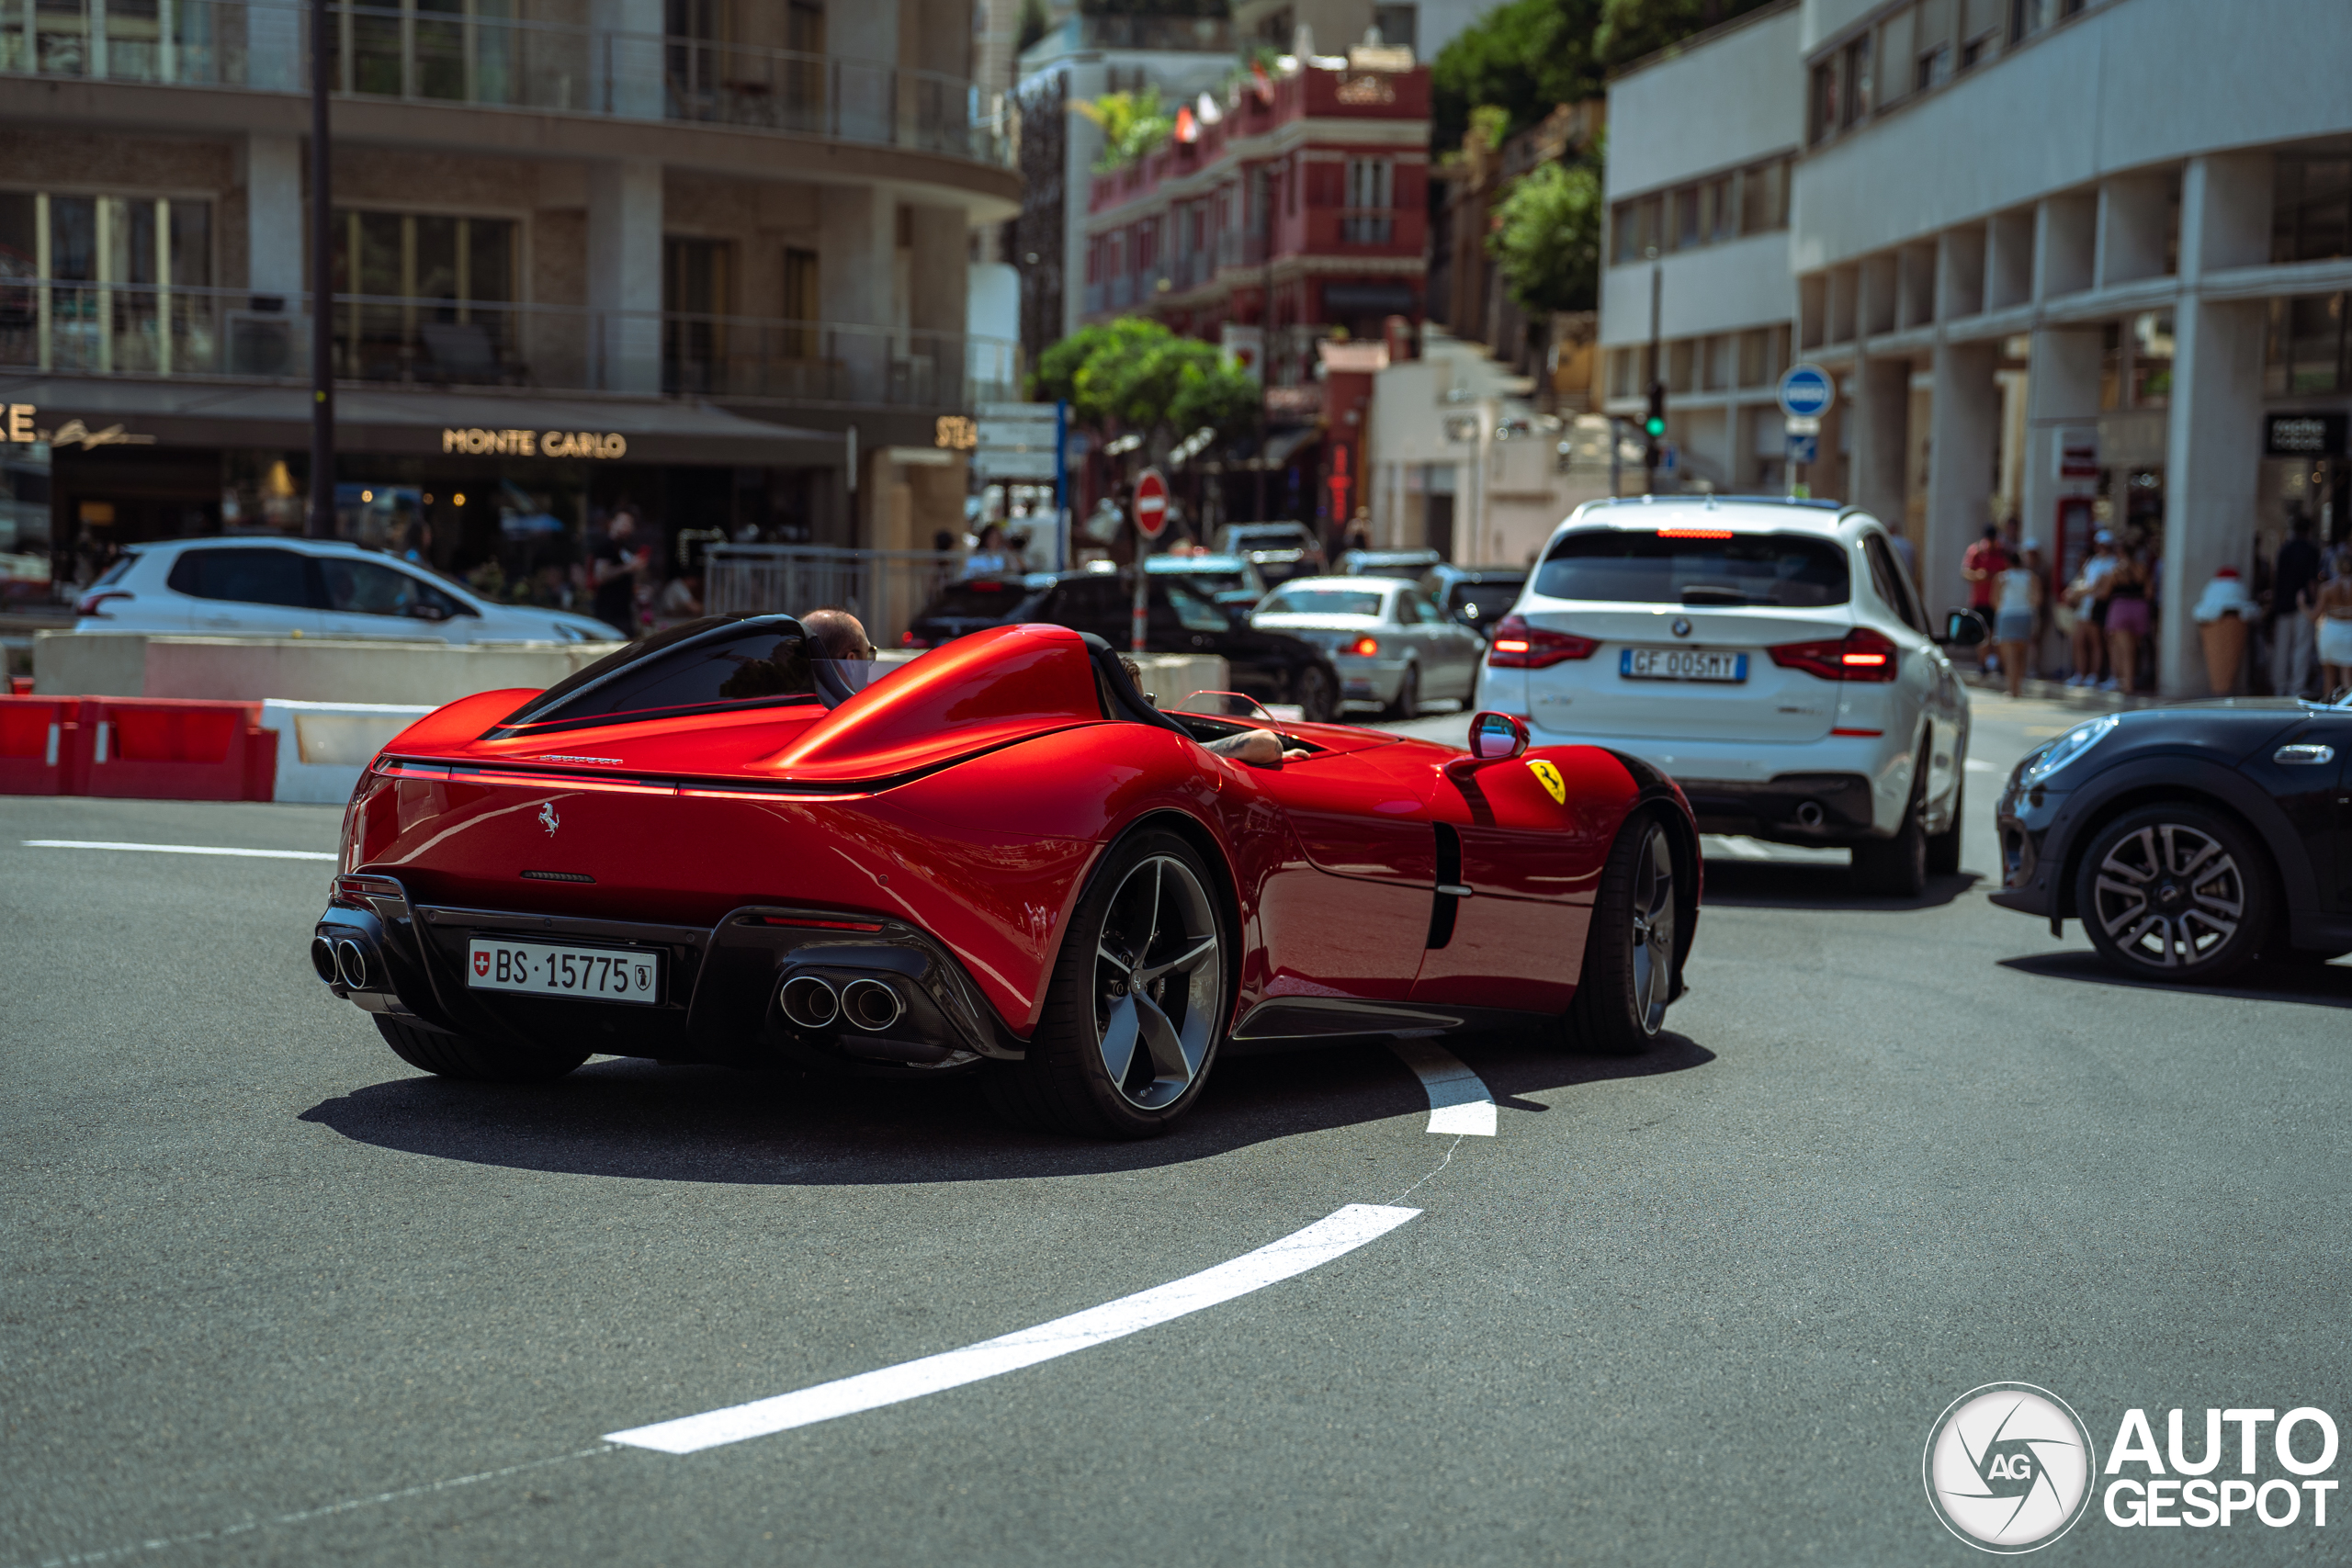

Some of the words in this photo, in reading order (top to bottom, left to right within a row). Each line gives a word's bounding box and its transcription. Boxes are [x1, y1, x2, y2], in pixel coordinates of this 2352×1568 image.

[443, 428, 537, 457] MONTE
[540, 431, 627, 459] CARLO
[1667, 651, 1733, 676] 005MY
